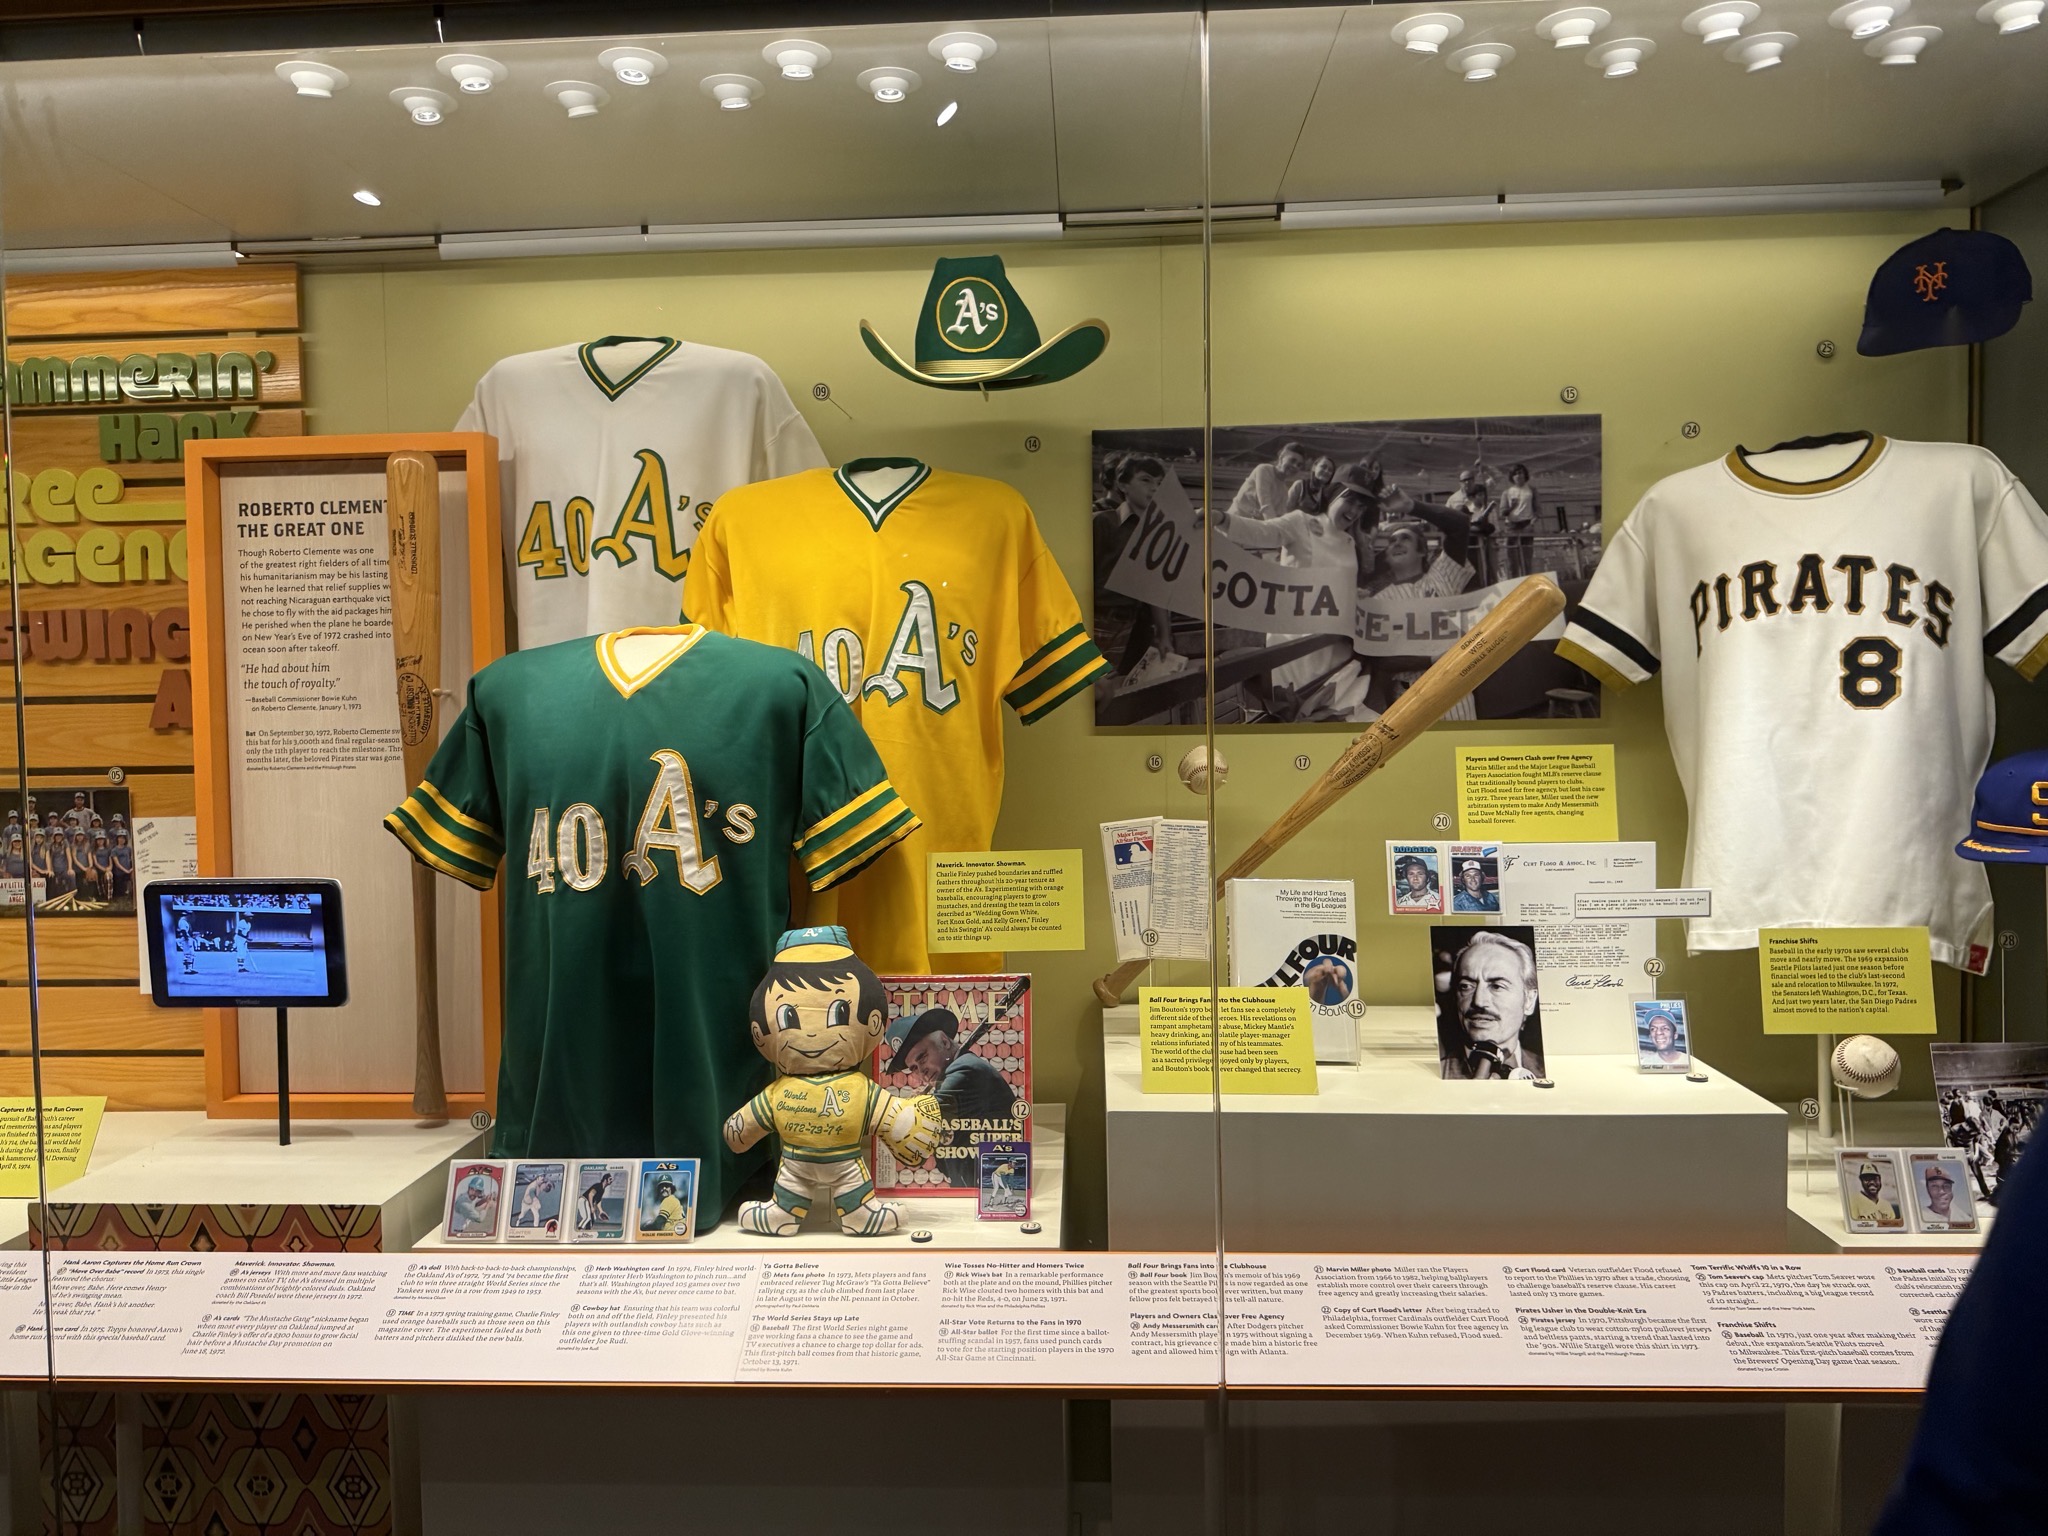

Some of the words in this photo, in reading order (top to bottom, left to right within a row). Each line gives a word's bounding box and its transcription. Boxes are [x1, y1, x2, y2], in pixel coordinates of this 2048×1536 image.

[946, 287, 998, 335] A's
[1821, 342, 1832, 354] 25
[816, 386, 827, 397] 09
[1565, 388, 1575, 400] 15
[1685, 424, 1697, 436] 24
[1028, 439, 1038, 450] 14
[239, 502, 314, 516] ROBERTO
[237, 524, 268, 537] THE
[274, 523, 325, 536] GREAT
[331, 522, 364, 535] ONE
[517, 496, 595, 580] 40
[1128, 500, 1190, 582] YOU
[238, 549, 267, 558] Though
[269, 548, 301, 556] Roberto
[240, 561, 248, 569] of
[266, 562, 296, 570] greatest
[299, 558, 317, 569] right
[320, 558, 349, 568] fielders
[351, 558, 359, 566] of
[1203, 559, 1340, 617] GOTTA
[1690, 553, 1955, 663] PIRATES
[862, 580, 979, 715] A's
[1469, 637, 1488, 655] WISE
[262, 663, 279, 673] had
[282, 662, 308, 673] about
[312, 661, 329, 672] him
[1839, 636, 1903, 710] 8
[244, 679, 259, 689] the
[261, 678, 287, 688] touch
[290, 678, 300, 690] of
[1151, 757, 1159, 767] 16
[1298, 758, 1307, 767] 17
[111, 770, 121, 781] 05
[527, 802, 608, 895] 40
[622, 748, 758, 896] A's
[1435, 816, 1448, 827] 20
[802, 925, 823, 937] A's
[1143, 933, 1155, 943] 18
[2002, 934, 2015, 946] 28
[1285, 934, 1357, 974] FOUR
[1648, 962, 1661, 973] 22
[893, 991, 1010, 1024] TIME
[1350, 1003, 1363, 1014] 19
[776, 1101, 817, 1114] Champions
[818, 1085, 850, 1117] A's
[783, 1089, 808, 1101] World
[1015, 1104, 1026, 1116] 12
[1804, 1102, 1816, 1115] 26
[475, 1114, 486, 1127] 10
[941, 1118, 1022, 1131] ASEBALL'S
[970, 1132, 1022, 1145] SUPER
[992, 1144, 1013, 1152] A's
[656, 1162, 679, 1171] A's
